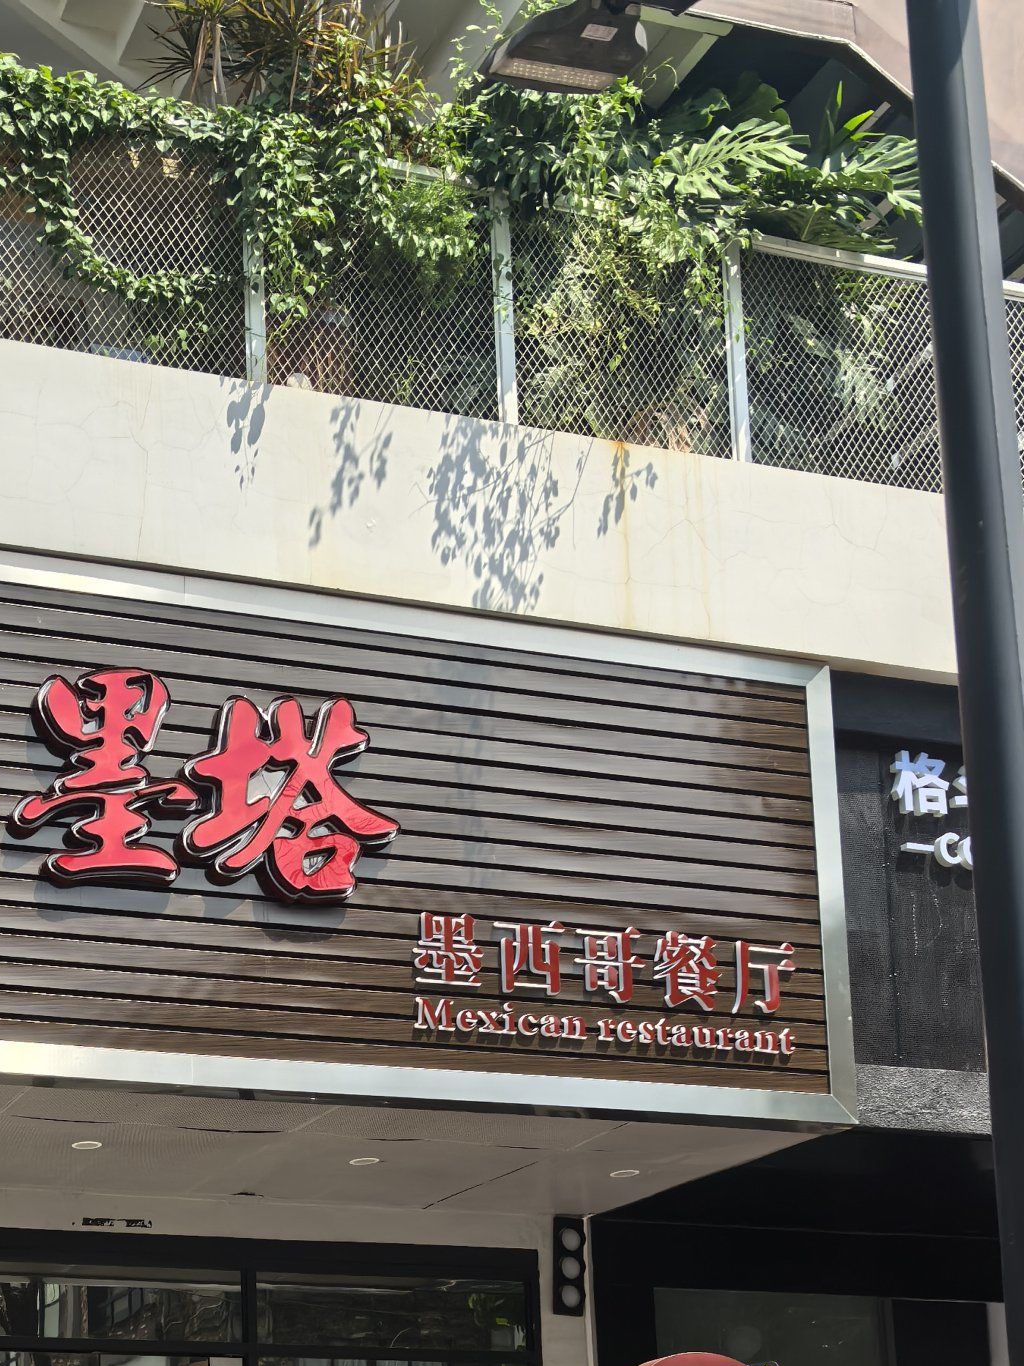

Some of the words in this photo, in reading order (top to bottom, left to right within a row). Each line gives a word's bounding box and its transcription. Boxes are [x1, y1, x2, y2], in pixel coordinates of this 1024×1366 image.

[413, 911, 796, 1014] 墨西哥餐厅
[414, 996, 587, 1041] Mexican
[598, 1016, 796, 1056] restaurant
